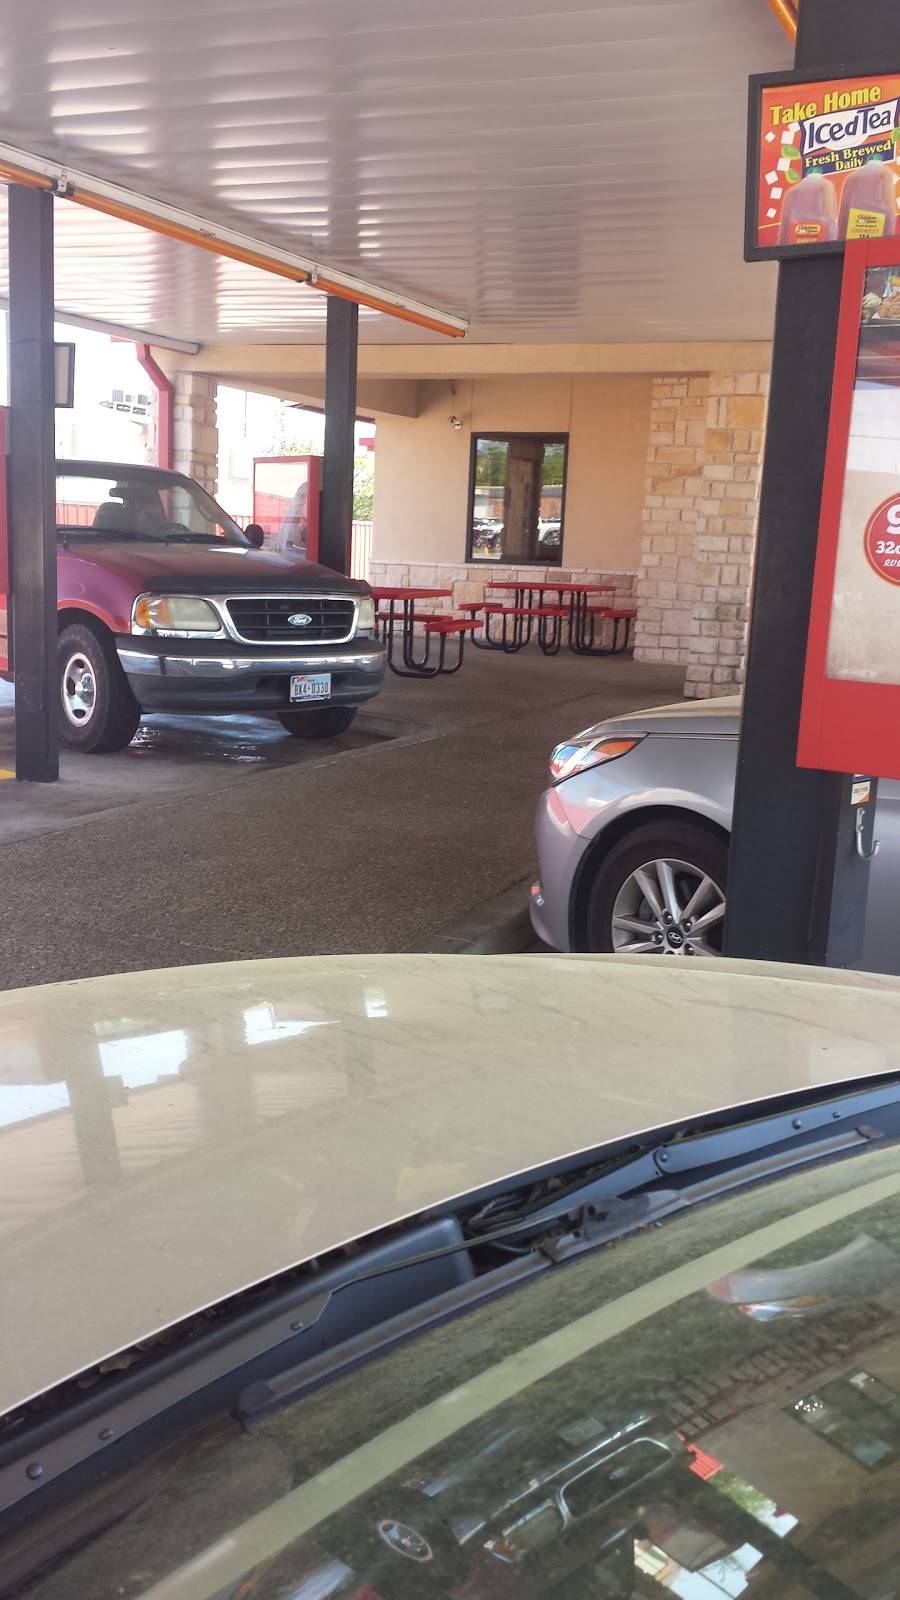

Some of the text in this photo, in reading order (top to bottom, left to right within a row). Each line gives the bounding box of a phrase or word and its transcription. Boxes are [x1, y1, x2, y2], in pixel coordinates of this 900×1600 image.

[770, 86, 881, 126] Take Home
[805, 140, 892, 168] Fresh Brewed
[835, 157, 864, 171] Daily
